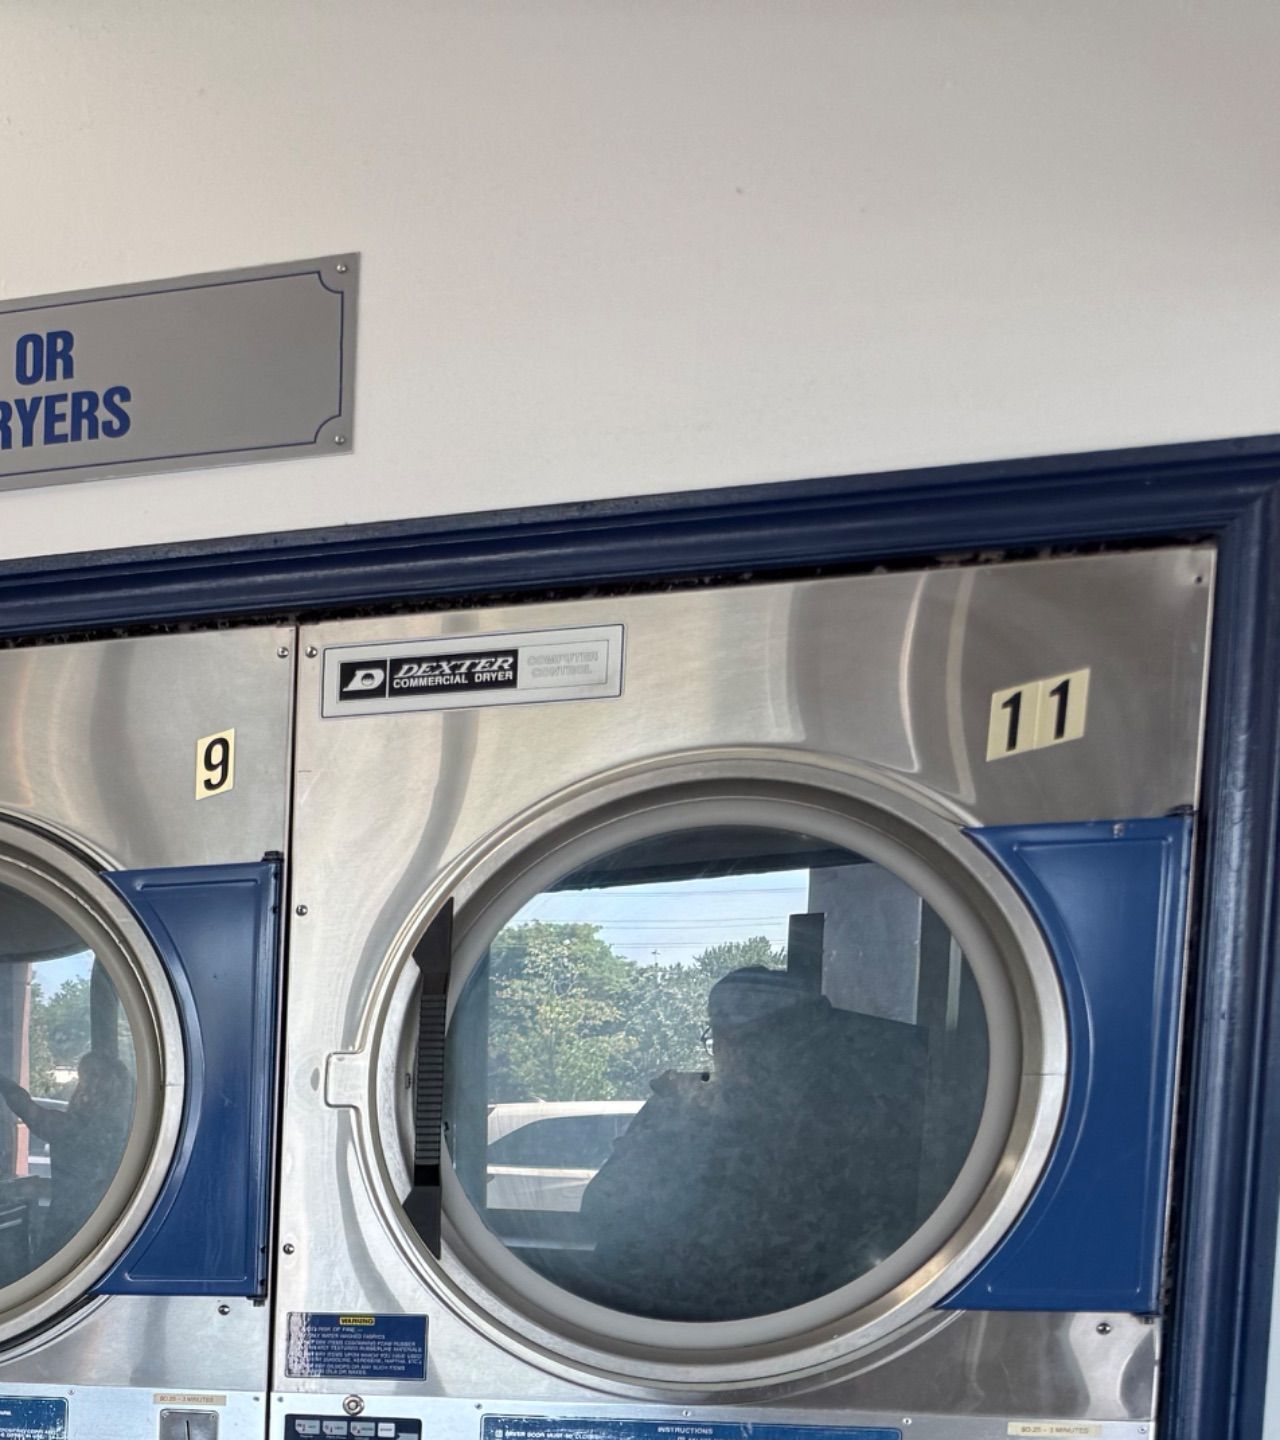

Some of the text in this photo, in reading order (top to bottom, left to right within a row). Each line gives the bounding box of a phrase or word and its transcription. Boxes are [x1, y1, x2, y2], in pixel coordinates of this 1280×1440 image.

[15, 330, 73, 384] OR
[393, 656, 515, 678] DEXTER
[393, 670, 513, 688] COMMERCIAL DRYER
[1002, 679, 1070, 751] 11
[204, 737, 229, 790] 9
[658, 1427, 713, 1435] INSTRUCTIONS
